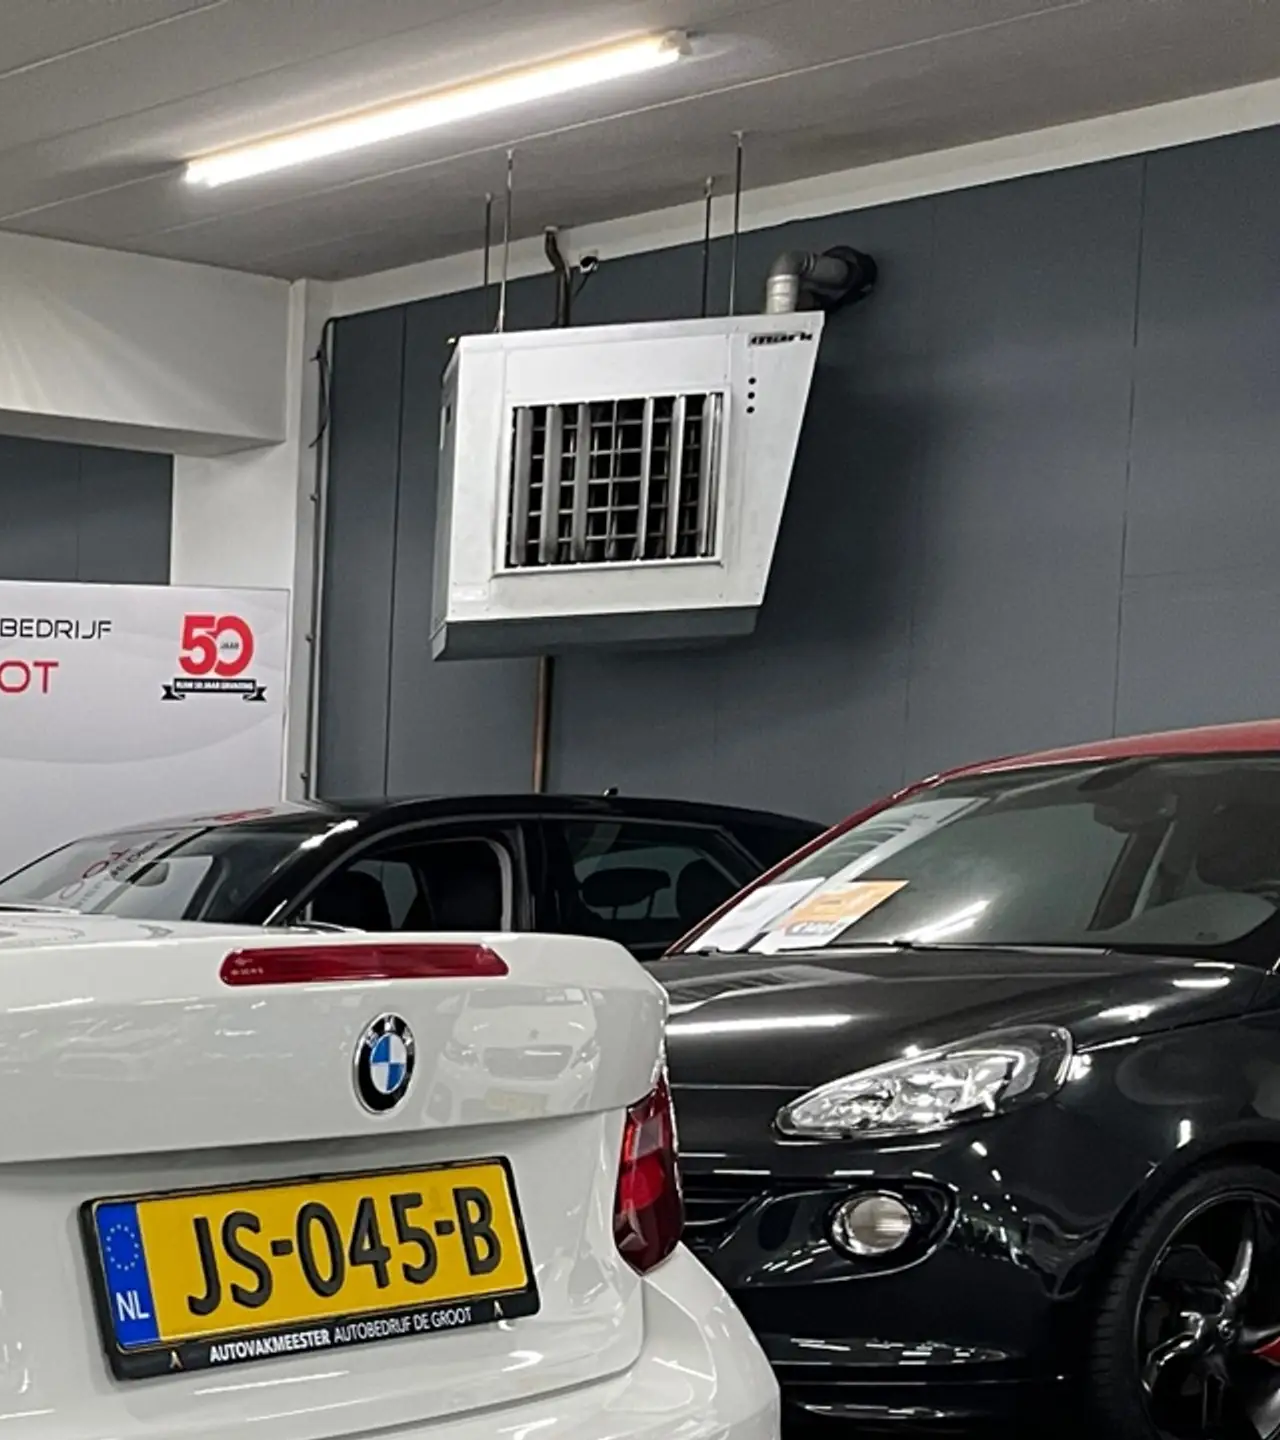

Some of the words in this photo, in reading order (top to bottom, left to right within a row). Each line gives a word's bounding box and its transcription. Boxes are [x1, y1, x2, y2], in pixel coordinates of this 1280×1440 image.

[178, 614, 254, 677] 50
[187, 1187, 502, 1317] JS-045-B
[116, 1290, 149, 1322] NL
[209, 1329, 331, 1362] AUTOVAKMEESTER
[334, 1316, 411, 1344] AUTOBEDRIJF
[414, 1313, 431, 1330] DE
[431, 1306, 471, 1328] GROOT
